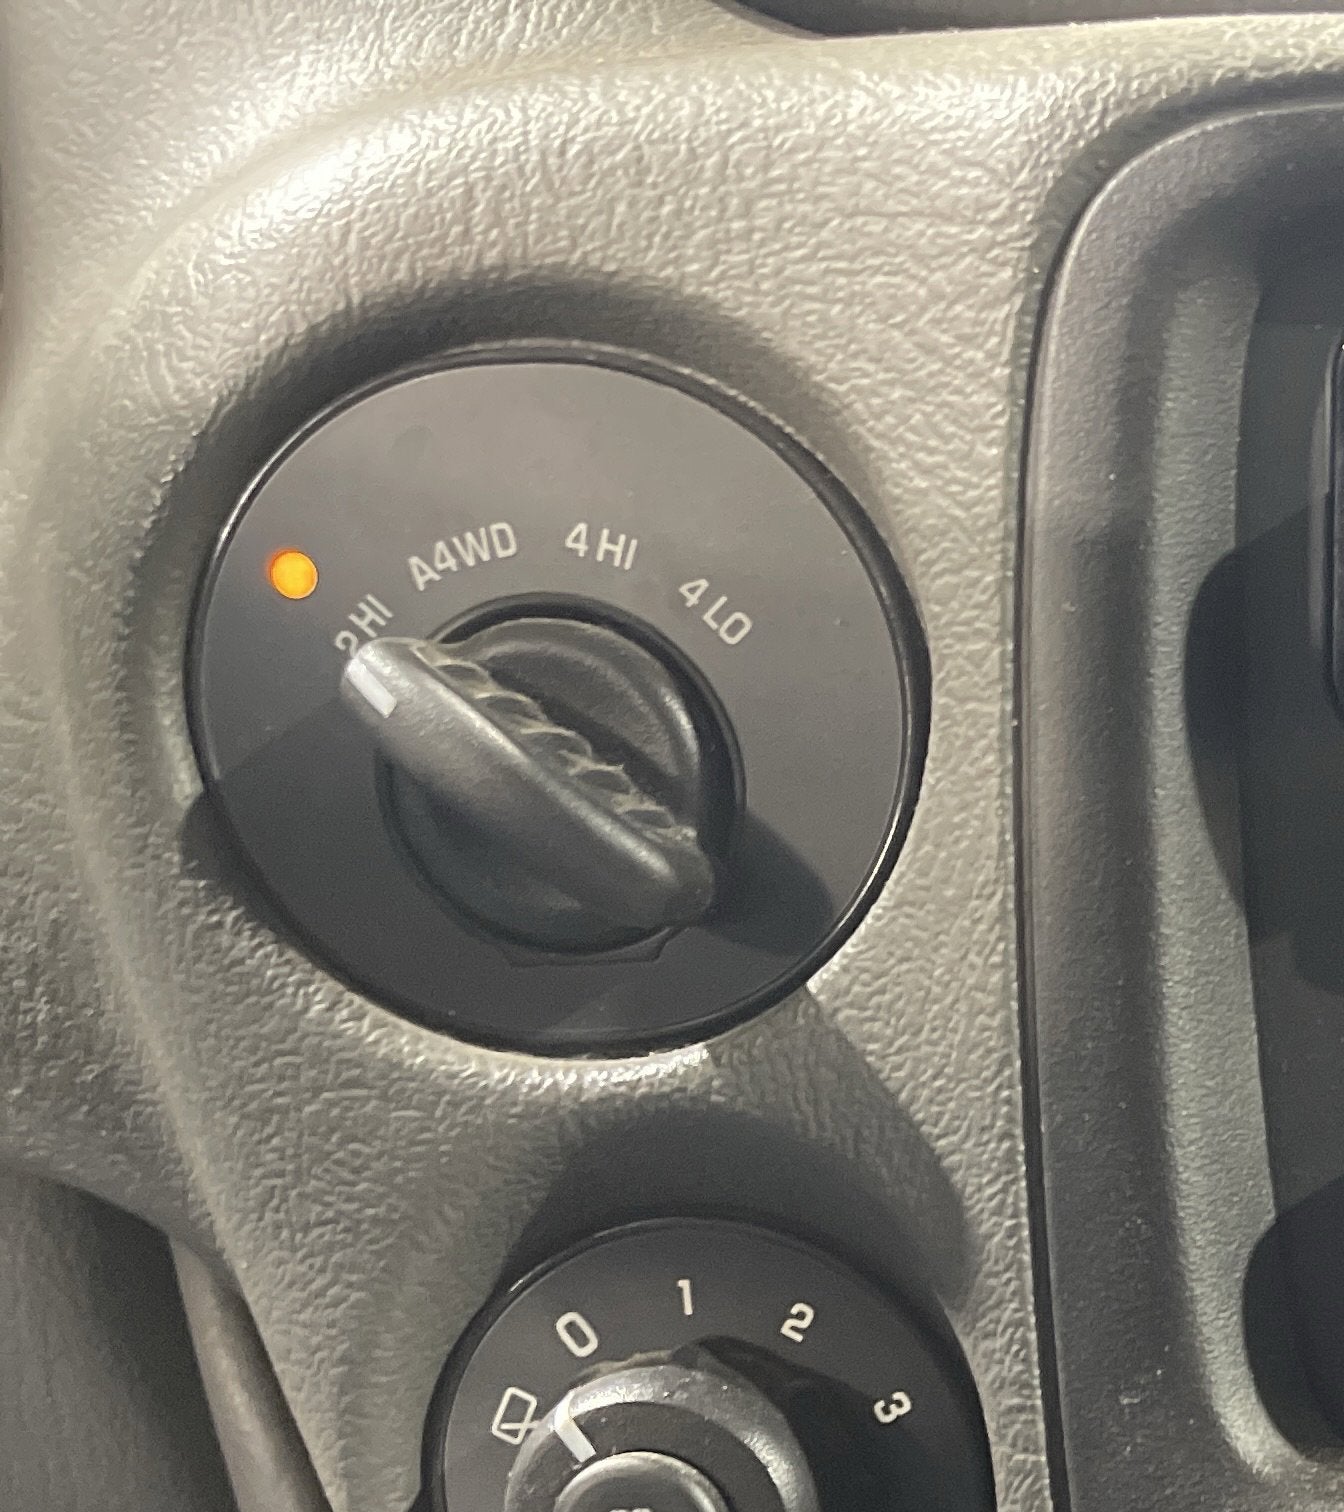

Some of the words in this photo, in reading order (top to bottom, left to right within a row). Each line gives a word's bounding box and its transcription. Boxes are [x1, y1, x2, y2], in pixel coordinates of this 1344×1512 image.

[407, 522, 518, 591] A4WD
[677, 1279, 694, 1316] 1
[780, 1302, 815, 1343] 2
[873, 1391, 912, 1424] 3
